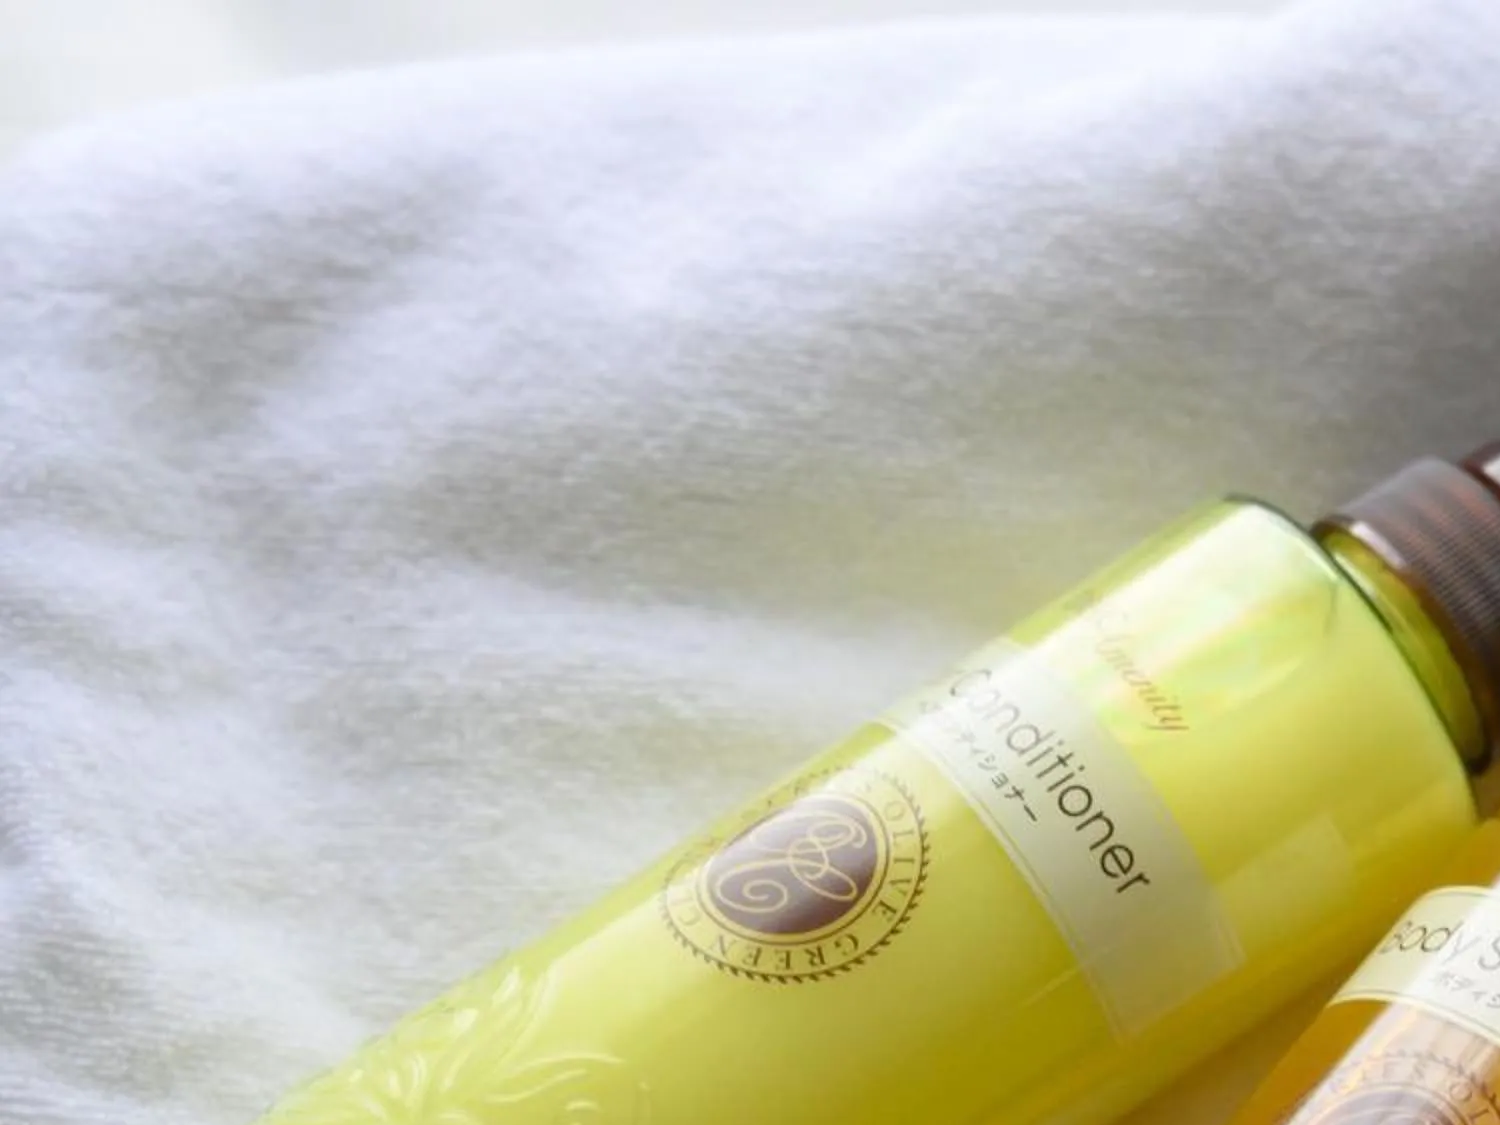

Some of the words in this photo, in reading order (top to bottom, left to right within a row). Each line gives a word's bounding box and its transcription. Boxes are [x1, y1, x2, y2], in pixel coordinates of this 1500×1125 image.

[918, 699, 1038, 823] コディショナー
[949, 668, 1150, 893] Conditioner
[872, 800, 915, 922] OLIVE
[707, 932, 860, 971] GREEN
[1378, 920, 1481, 965] Body
